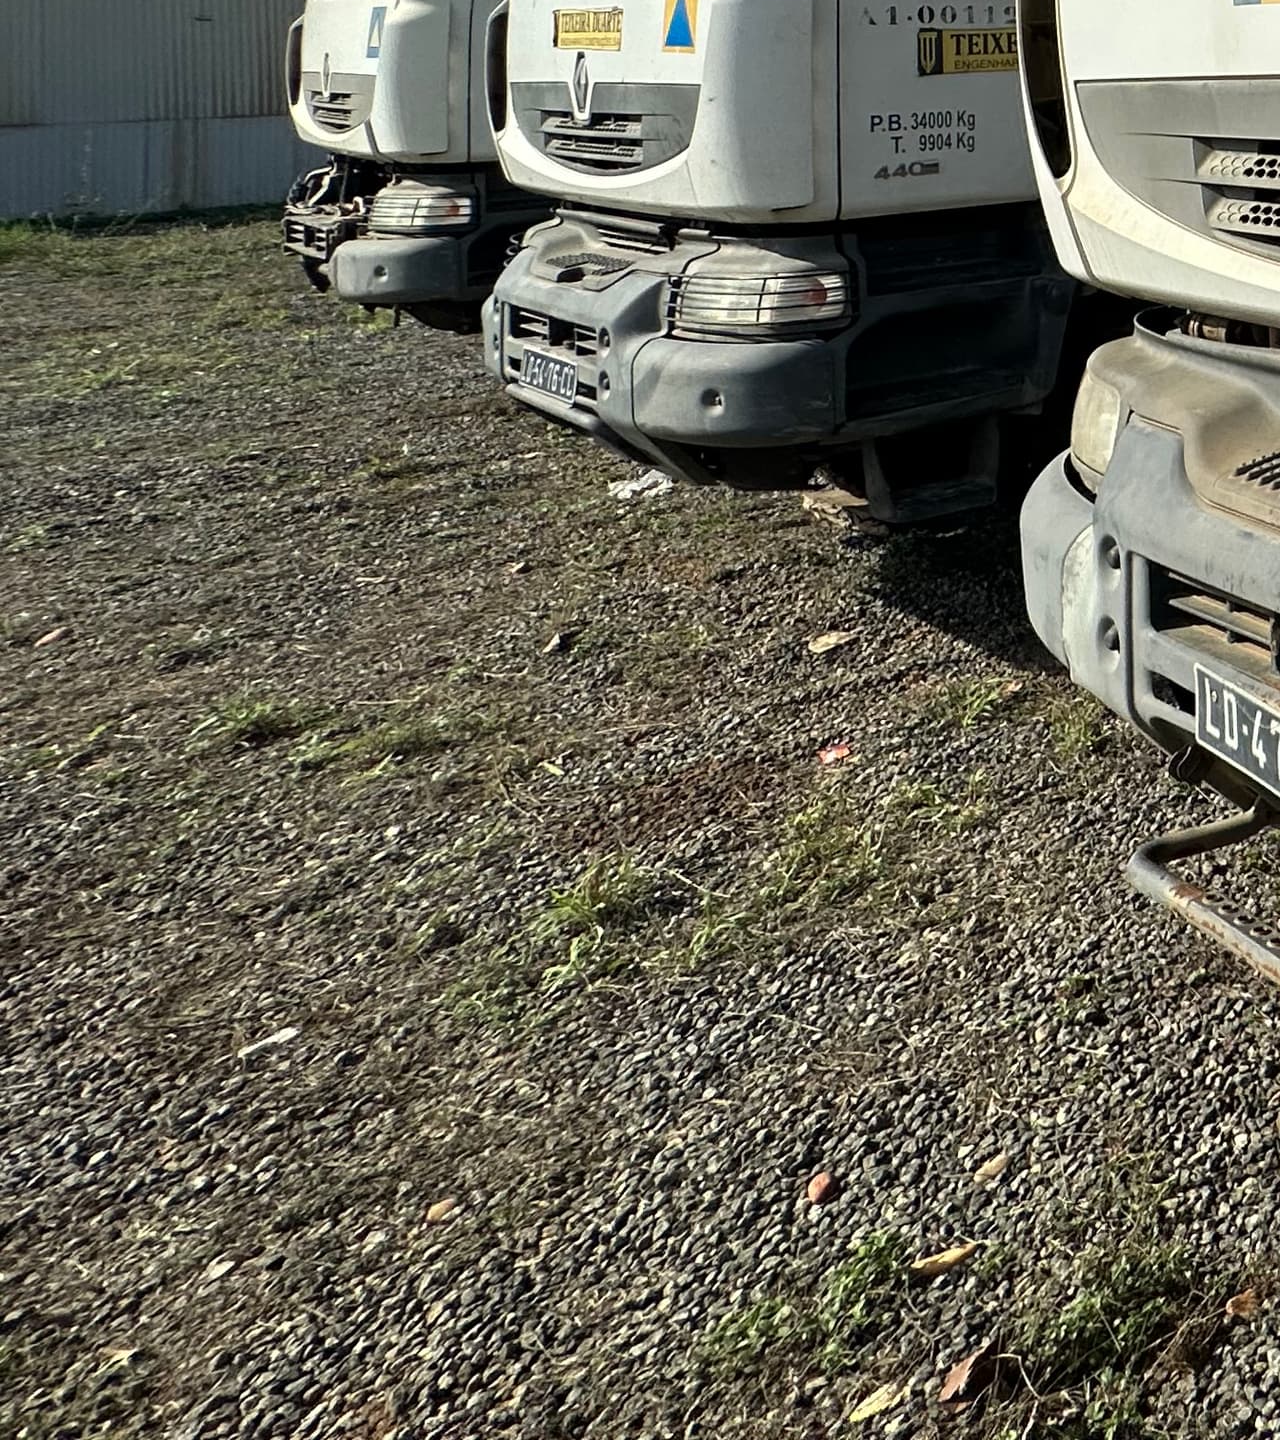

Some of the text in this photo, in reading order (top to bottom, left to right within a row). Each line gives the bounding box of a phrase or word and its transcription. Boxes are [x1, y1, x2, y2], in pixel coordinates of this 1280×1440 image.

[869, 110, 976, 133] P.B. 34000 Kg
[891, 132, 975, 154] T. 9904 Kg
